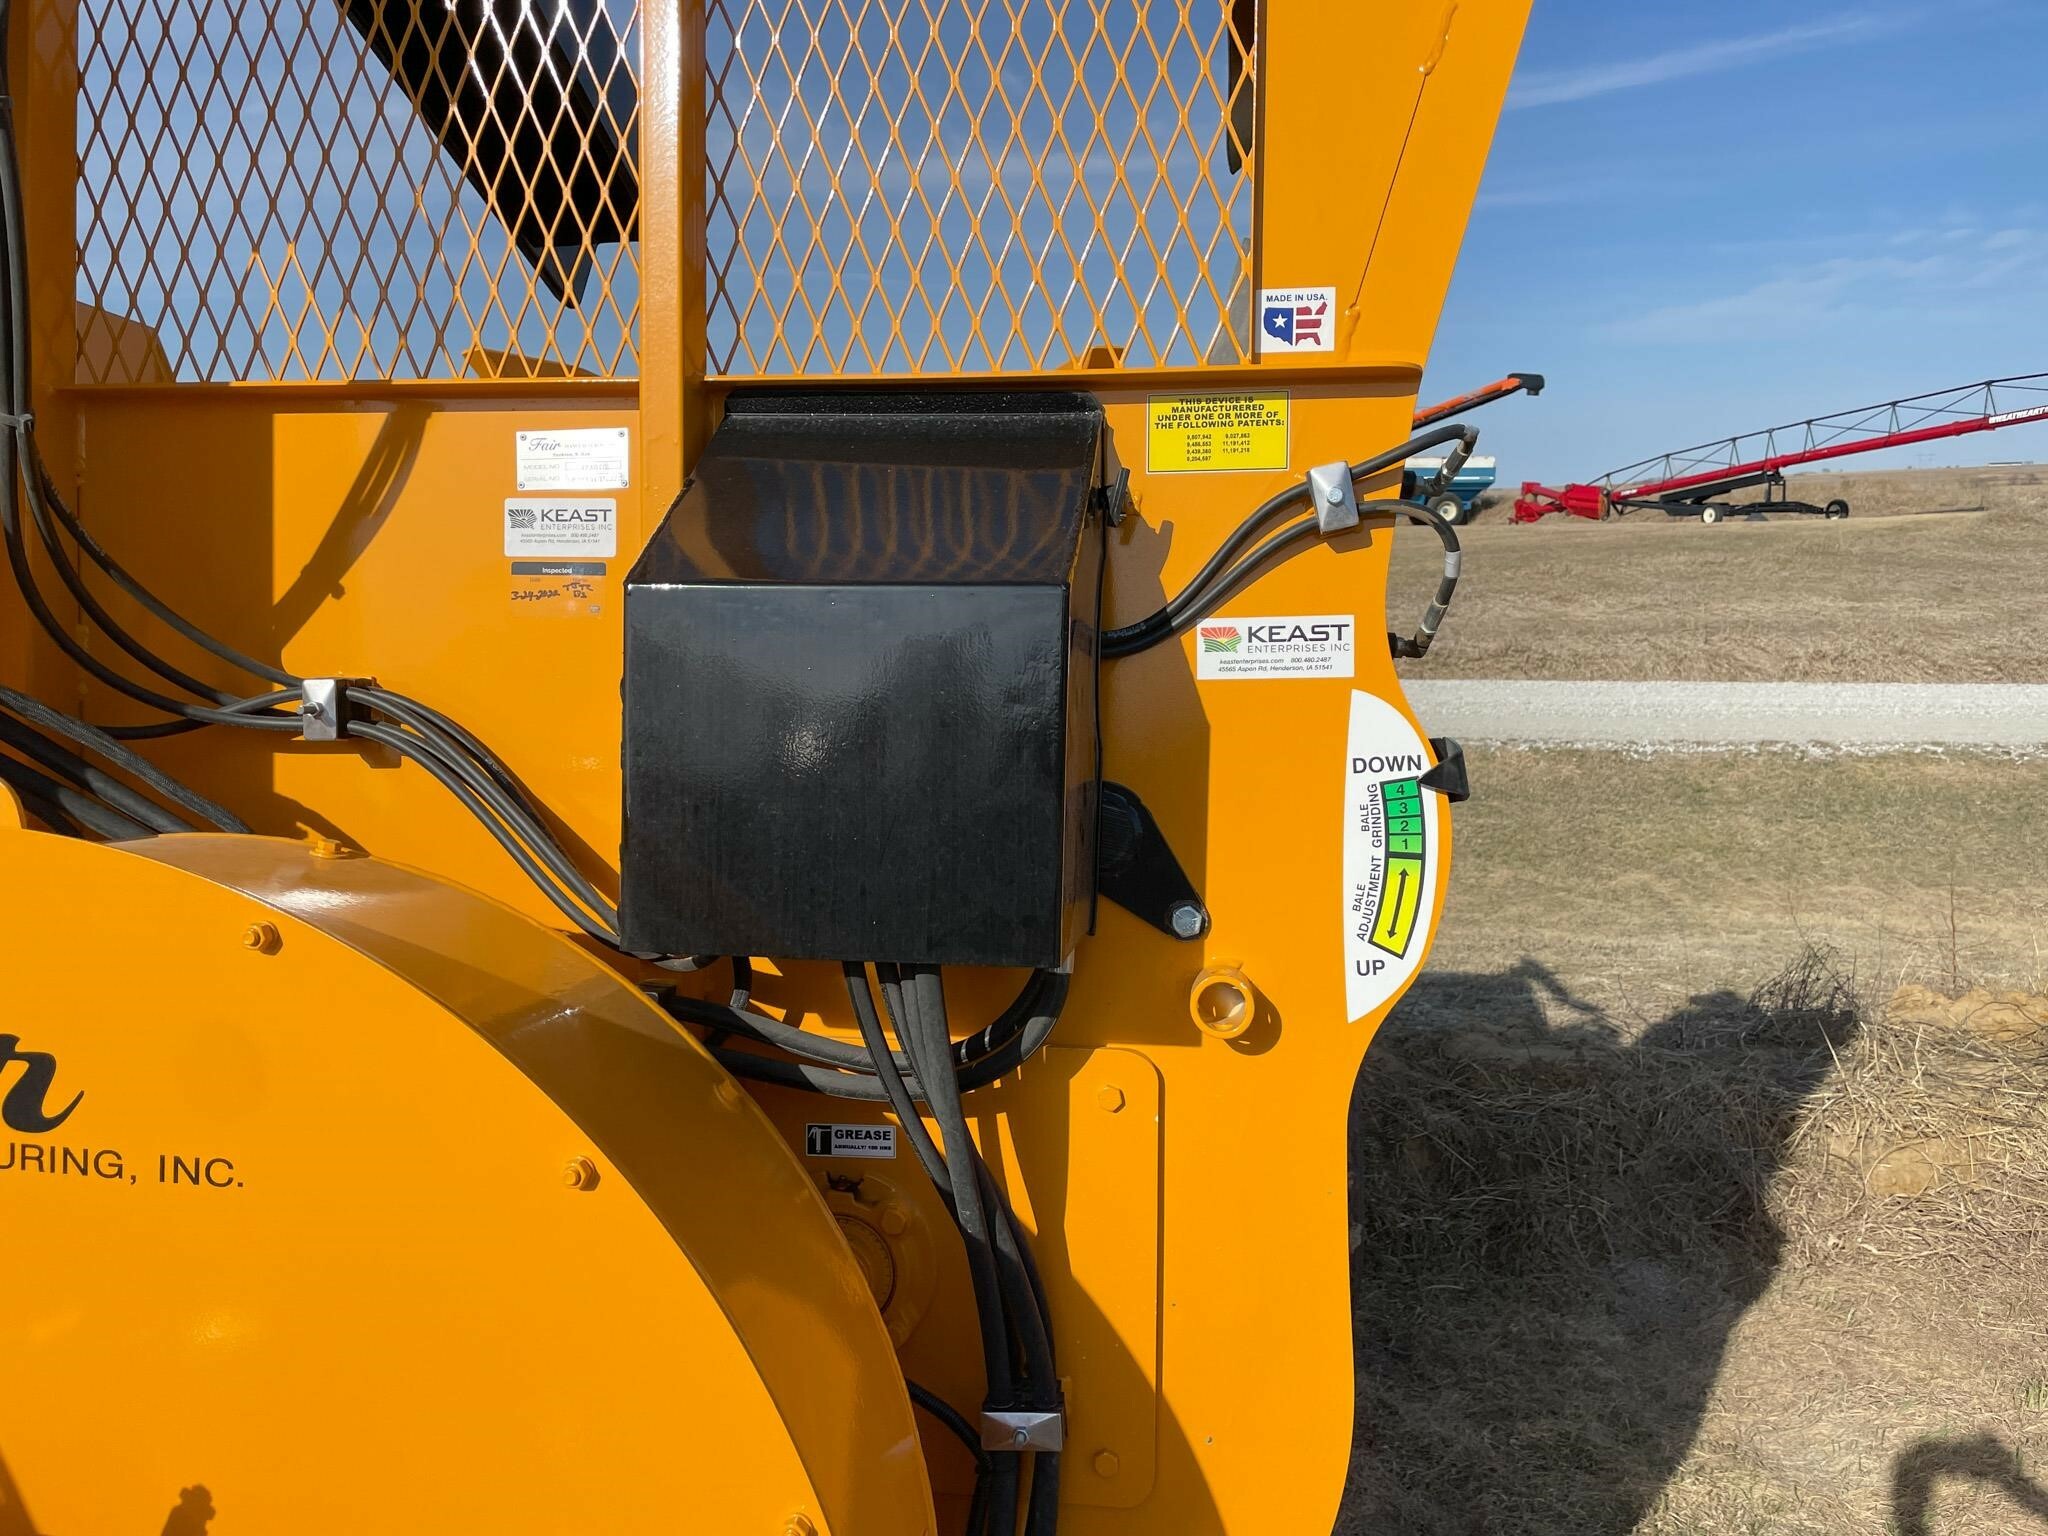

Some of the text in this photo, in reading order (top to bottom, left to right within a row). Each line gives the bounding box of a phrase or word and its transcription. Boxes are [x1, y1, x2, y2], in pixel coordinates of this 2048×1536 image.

[1266, 294, 1292, 302] MADE
[1202, 396, 1241, 404] DEVICE
[1171, 403, 1265, 413] MANUFACTURERED
[1157, 413, 1191, 422] UNDER
[1194, 413, 1215, 421] ONE
[1217, 412, 1232, 420] OR
[1234, 411, 1262, 419] MORE
[1154, 419, 1285, 429] THE FOLLOWING PATENTS:
[528, 437, 560, 452] Fair
[541, 508, 612, 522] KEAST
[540, 523, 613, 531] ENTERPRISES INC
[542, 567, 573, 575] Inspected
[1247, 624, 1350, 643] KEAST
[1247, 643, 1350, 654] ENTERPRISES INC
[1219, 658, 1284, 666] keastenterprises.com
[1237, 665, 1257, 673] Aspen
[1352, 754, 1422, 774] DOWN
[1396, 784, 1405, 795] 4
[1399, 802, 1408, 814] 3
[1360, 803, 1370, 832] BALE
[1367, 783, 1383, 848] GRINDING
[1400, 820, 1409, 832] 2
[1401, 838, 1408, 850] 1
[1352, 883, 1366, 912] BALE
[1356, 855, 1382, 942] ADJUSTMENT
[1356, 959, 1385, 977] UP
[834, 1129, 892, 1141] GREASE
[159, 1154, 244, 1188] INC.
